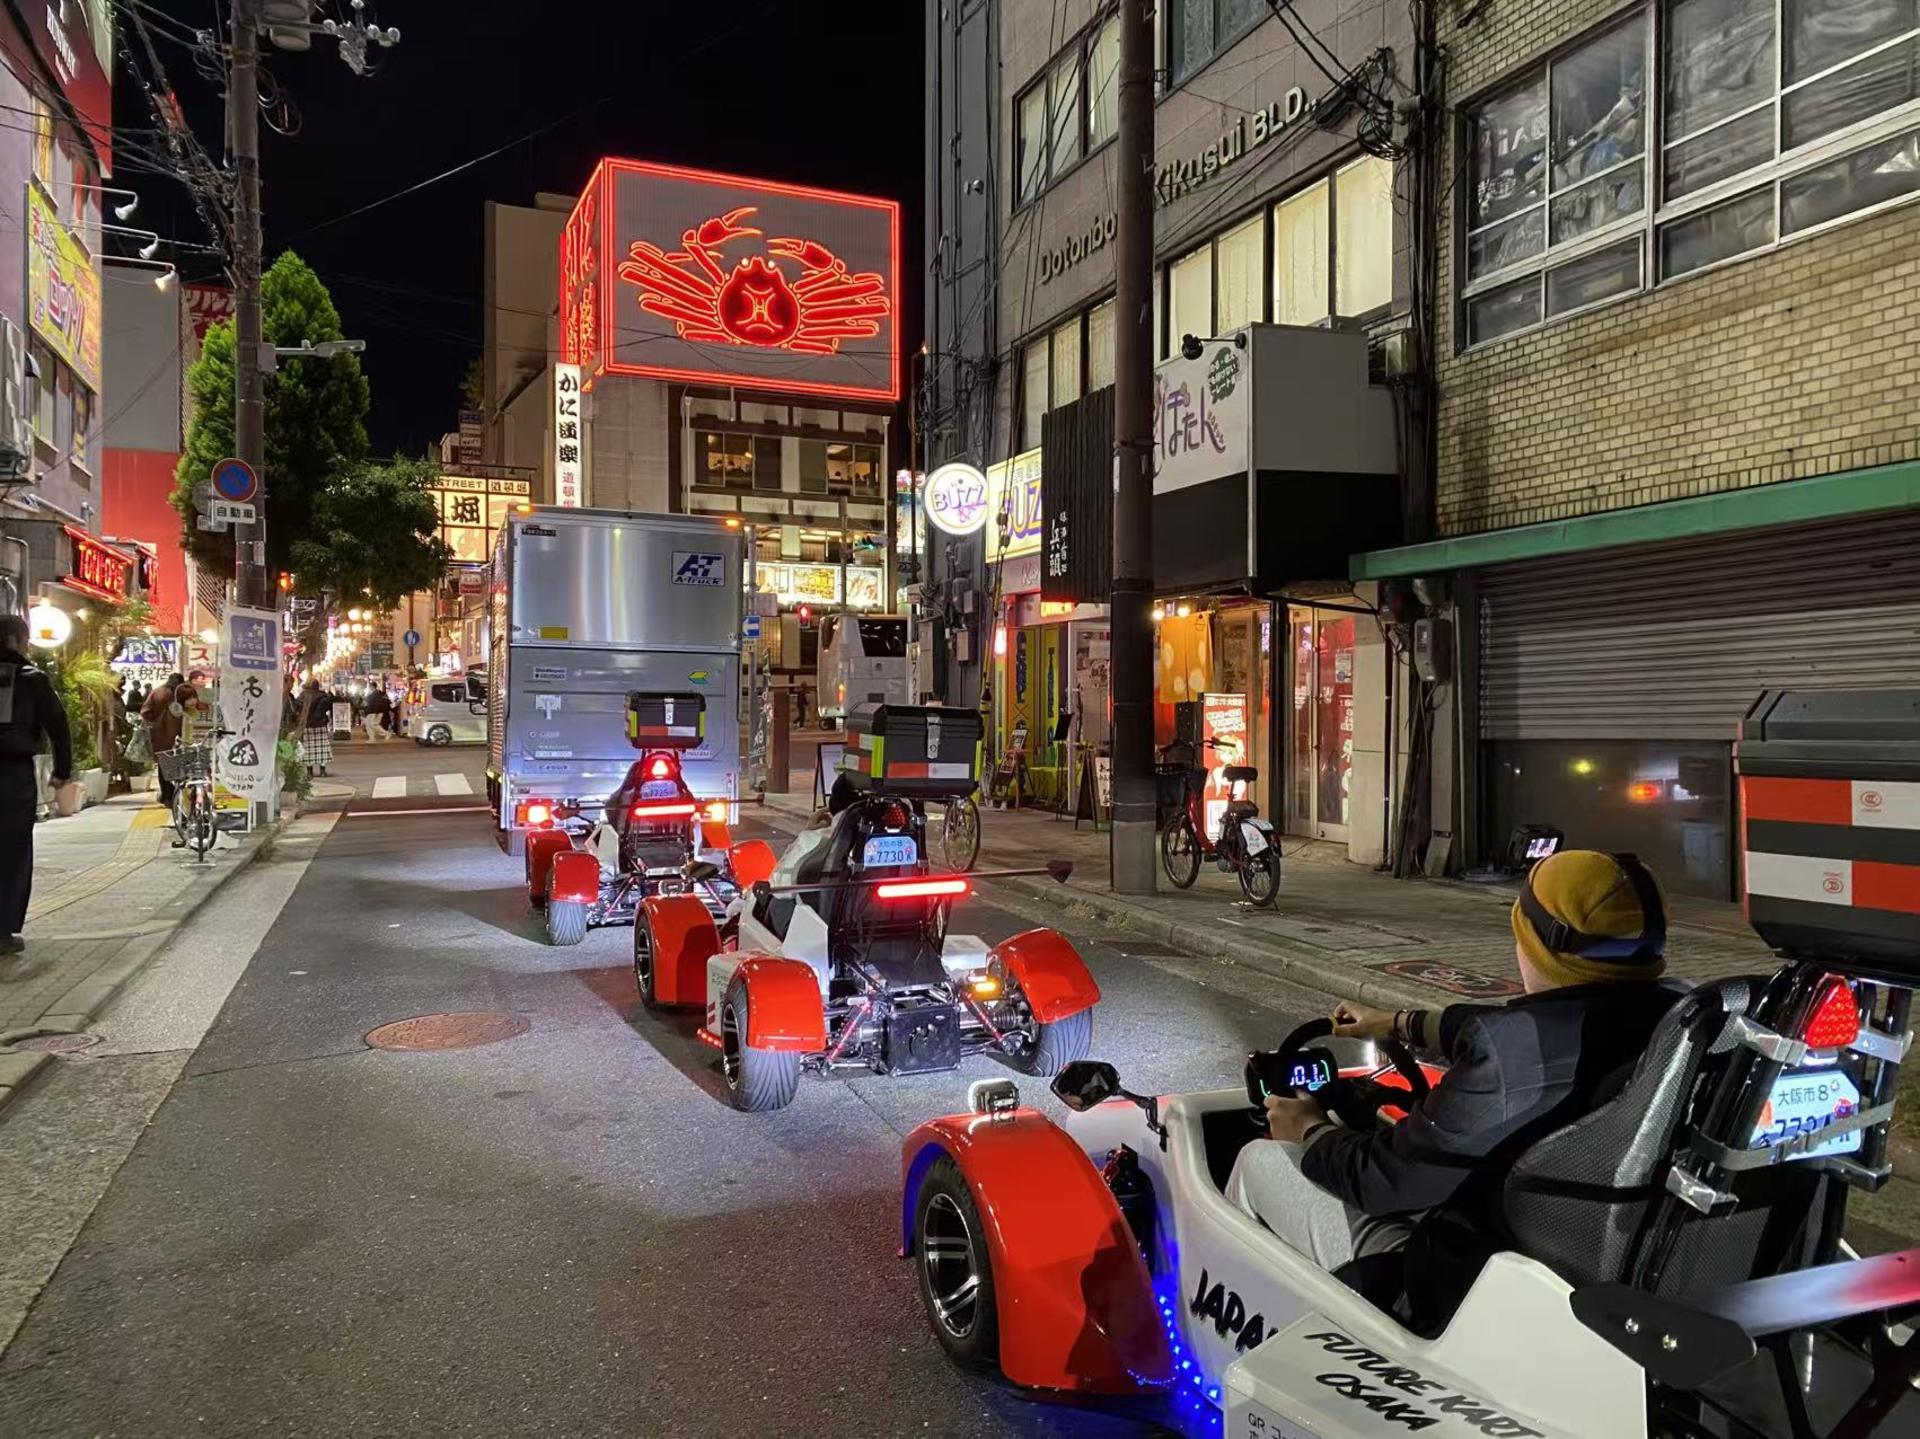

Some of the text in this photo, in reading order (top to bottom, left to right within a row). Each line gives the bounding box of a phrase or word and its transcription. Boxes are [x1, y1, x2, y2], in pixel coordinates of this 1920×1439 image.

[216, 506, 253, 519] 自動車
[876, 850, 904, 863] 7730
[1189, 1267, 1279, 1353] JAPA
[1303, 1332, 1546, 1439] FUTURE KART
[1314, 1372, 1441, 1432] OSAKA
[1248, 1413, 1265, 1432] QR
